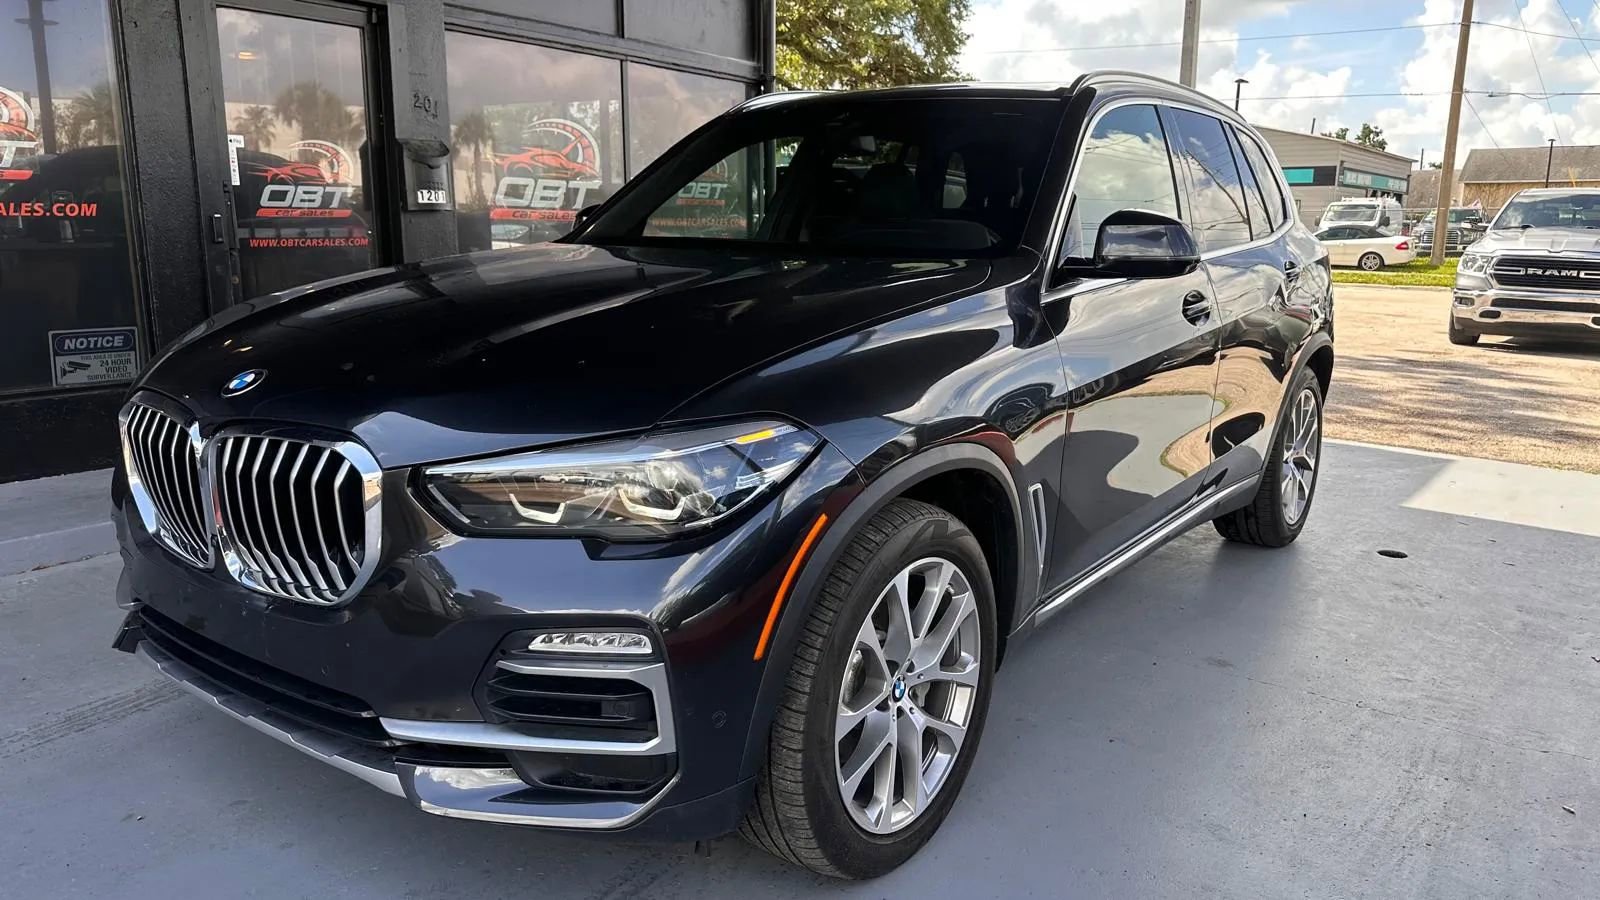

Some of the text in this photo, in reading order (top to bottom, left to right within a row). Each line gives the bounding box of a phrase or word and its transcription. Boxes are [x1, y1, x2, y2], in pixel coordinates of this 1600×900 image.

[259, 184, 356, 208] OBT
[419, 190, 445, 202] 1201
[495, 176, 602, 209] OBT
[677, 182, 728, 199] OBT
[275, 209, 334, 217] car sales
[511, 210, 535, 219] car
[249, 238, 369, 248] WWW.OBTCARSALES.COM
[1527, 267, 1578, 277] RAM
[64, 336, 124, 350] NOTICE
[111, 358, 132, 366] HOUR
